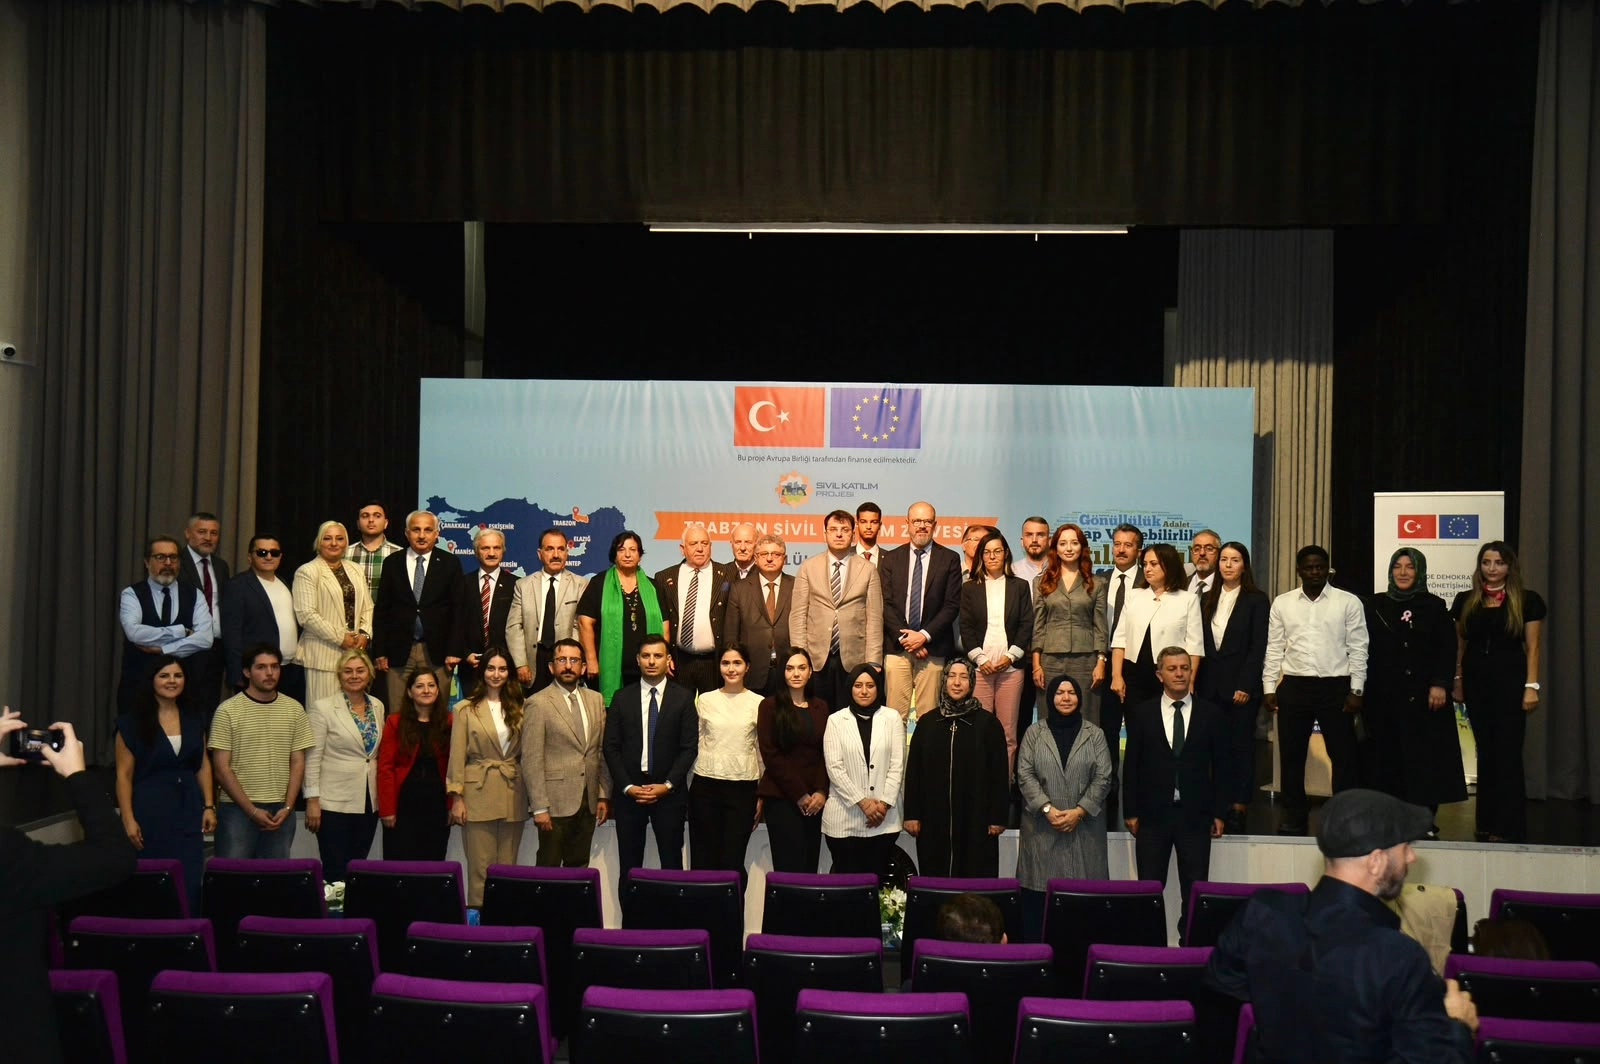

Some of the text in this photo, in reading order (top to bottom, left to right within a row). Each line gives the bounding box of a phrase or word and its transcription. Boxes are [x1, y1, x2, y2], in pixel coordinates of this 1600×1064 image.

[792, 455, 811, 463] Birliği
[812, 455, 847, 463] tarafından
[873, 456, 917, 464] edilmektedir.
[1079, 514, 1161, 527] Gönüllülük
[1162, 520, 1190, 528] Adalet
[441, 522, 470, 530] ÇANAKKALE
[488, 522, 514, 530] ESKİŞEHİR
[773, 520, 817, 536] SİVİL
[454, 547, 475, 555] MANİSA
